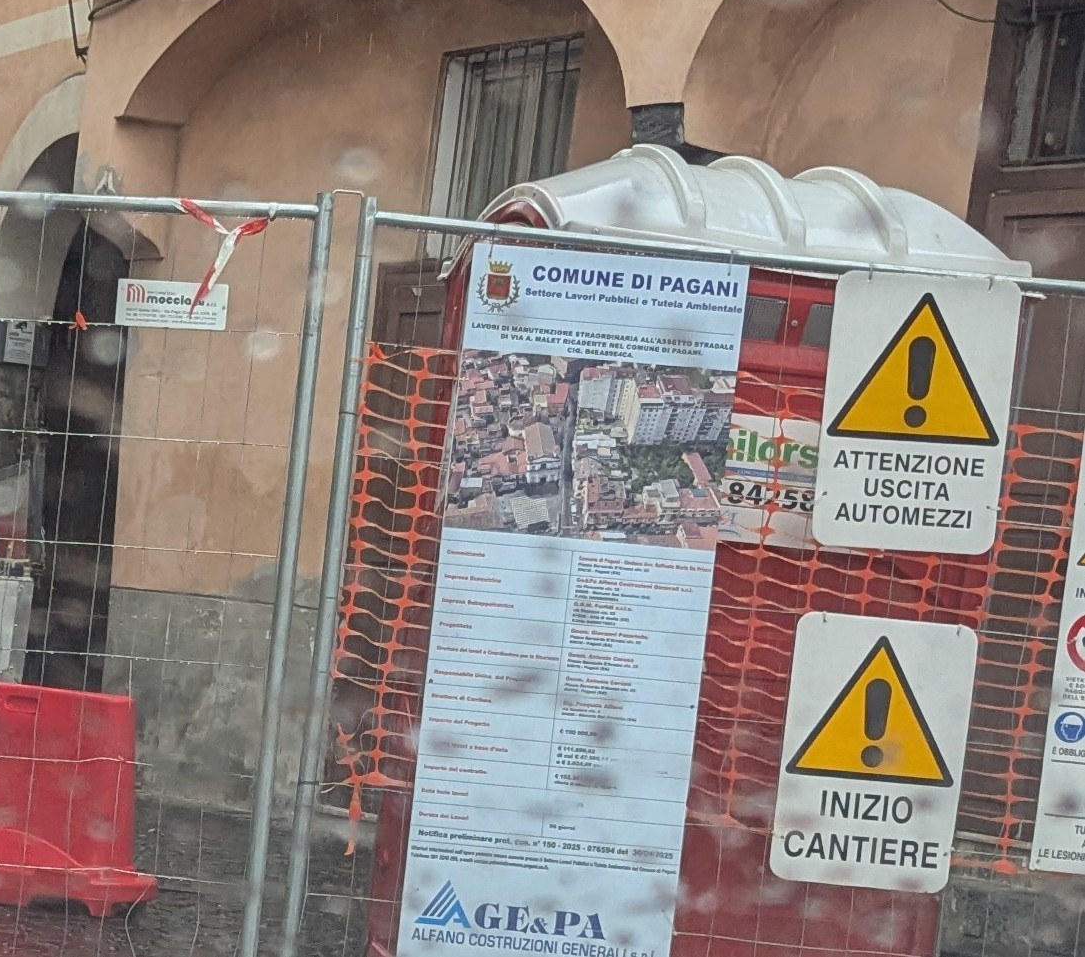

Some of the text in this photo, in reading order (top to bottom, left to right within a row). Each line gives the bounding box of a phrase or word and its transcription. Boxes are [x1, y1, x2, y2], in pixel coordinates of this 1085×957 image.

[532, 265, 739, 298] COMUNE DI PAGANI
[525, 287, 743, 314] Settore Lavori Pubblici e Tutela Ambientale
[471, 322, 499, 330] LAVORI
[626, 344, 660, 352] COMUNE
[834, 449, 985, 478] ATTENZIONE
[863, 478, 950, 503] USCITA
[834, 503, 973, 530] AUTOMEZZI
[820, 789, 913, 825] INIZIO
[418, 829, 448, 839] Notifica
[449, 832, 492, 843] preliminare
[782, 830, 939, 870] CANTIERE
[474, 902, 606, 941] GE&PA
[411, 927, 465, 945] ALFANO
[469, 933, 558, 954] COSTRUZIONI
